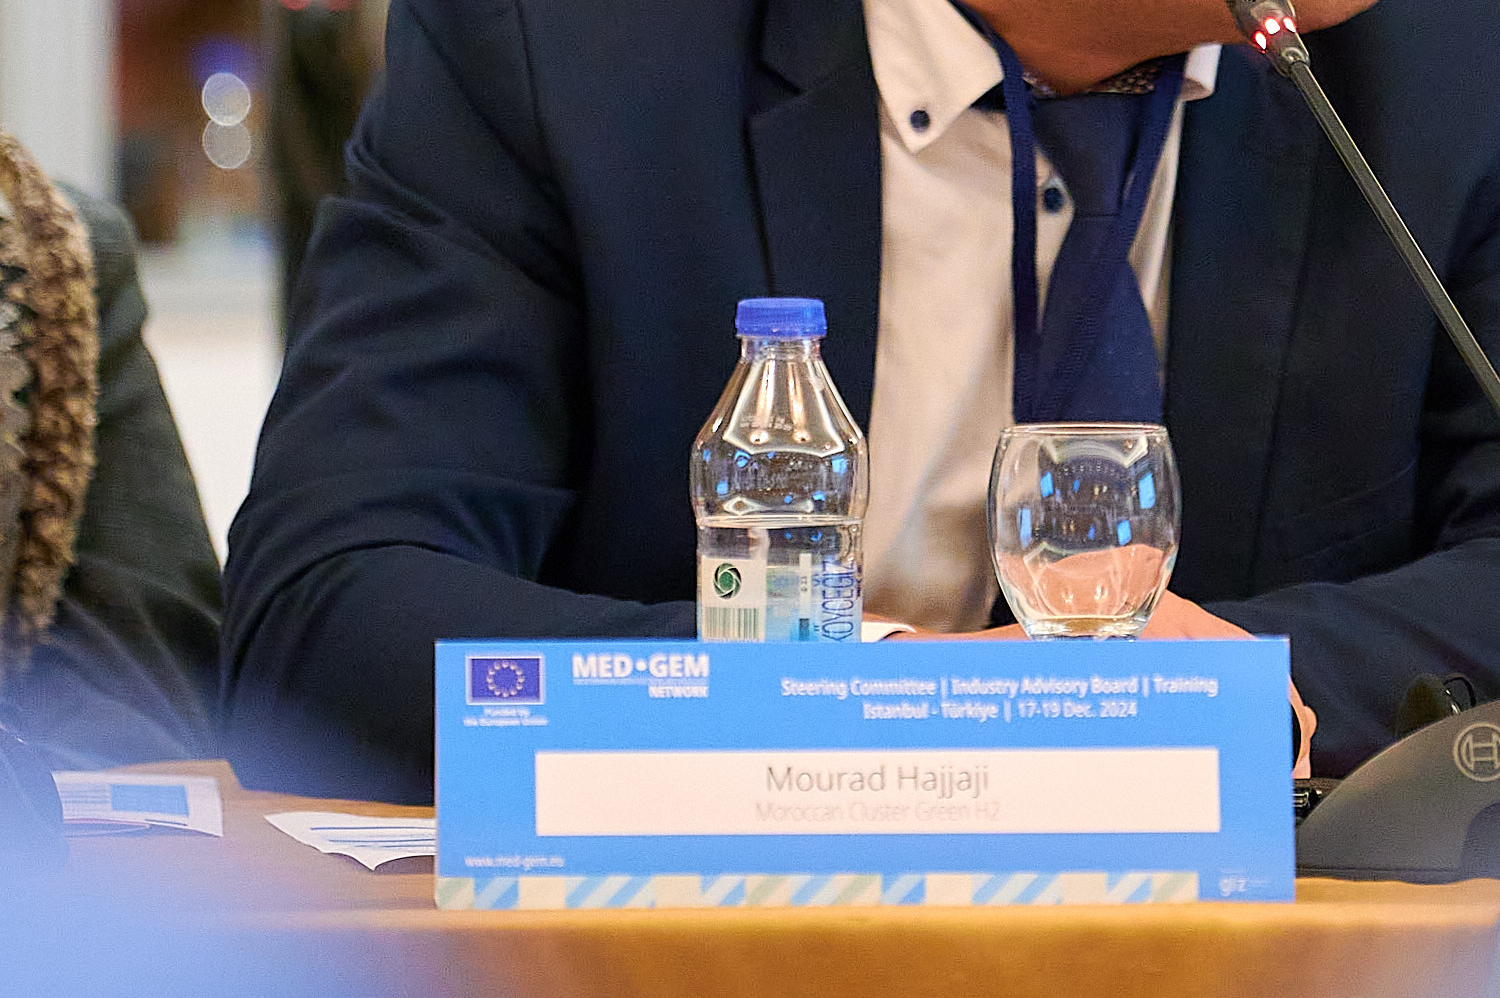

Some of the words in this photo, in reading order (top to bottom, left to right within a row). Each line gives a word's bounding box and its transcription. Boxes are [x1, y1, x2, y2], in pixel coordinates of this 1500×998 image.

[648, 685, 709, 698] NETWORK
[781, 677, 848, 700] Steering
[850, 677, 936, 695] Committee
[951, 677, 1018, 699] Industry
[1020, 676, 1088, 698] Advisory
[1090, 676, 1138, 694] Board
[1153, 675, 1218, 697] Training
[863, 702, 929, 719] Istanbul
[941, 701, 999, 723] Türkiye
[1018, 701, 1060, 718] 17-19
[1063, 701, 1096, 718] Dec.
[1100, 701, 1137, 718] 2024
[766, 764, 886, 792] Mourad
[897, 764, 989, 799] Hajjaji
[756, 802, 842, 822] Moroccan
[851, 801, 909, 821] Cluster
[916, 801, 968, 821] Green
[976, 801, 1000, 821] H2
